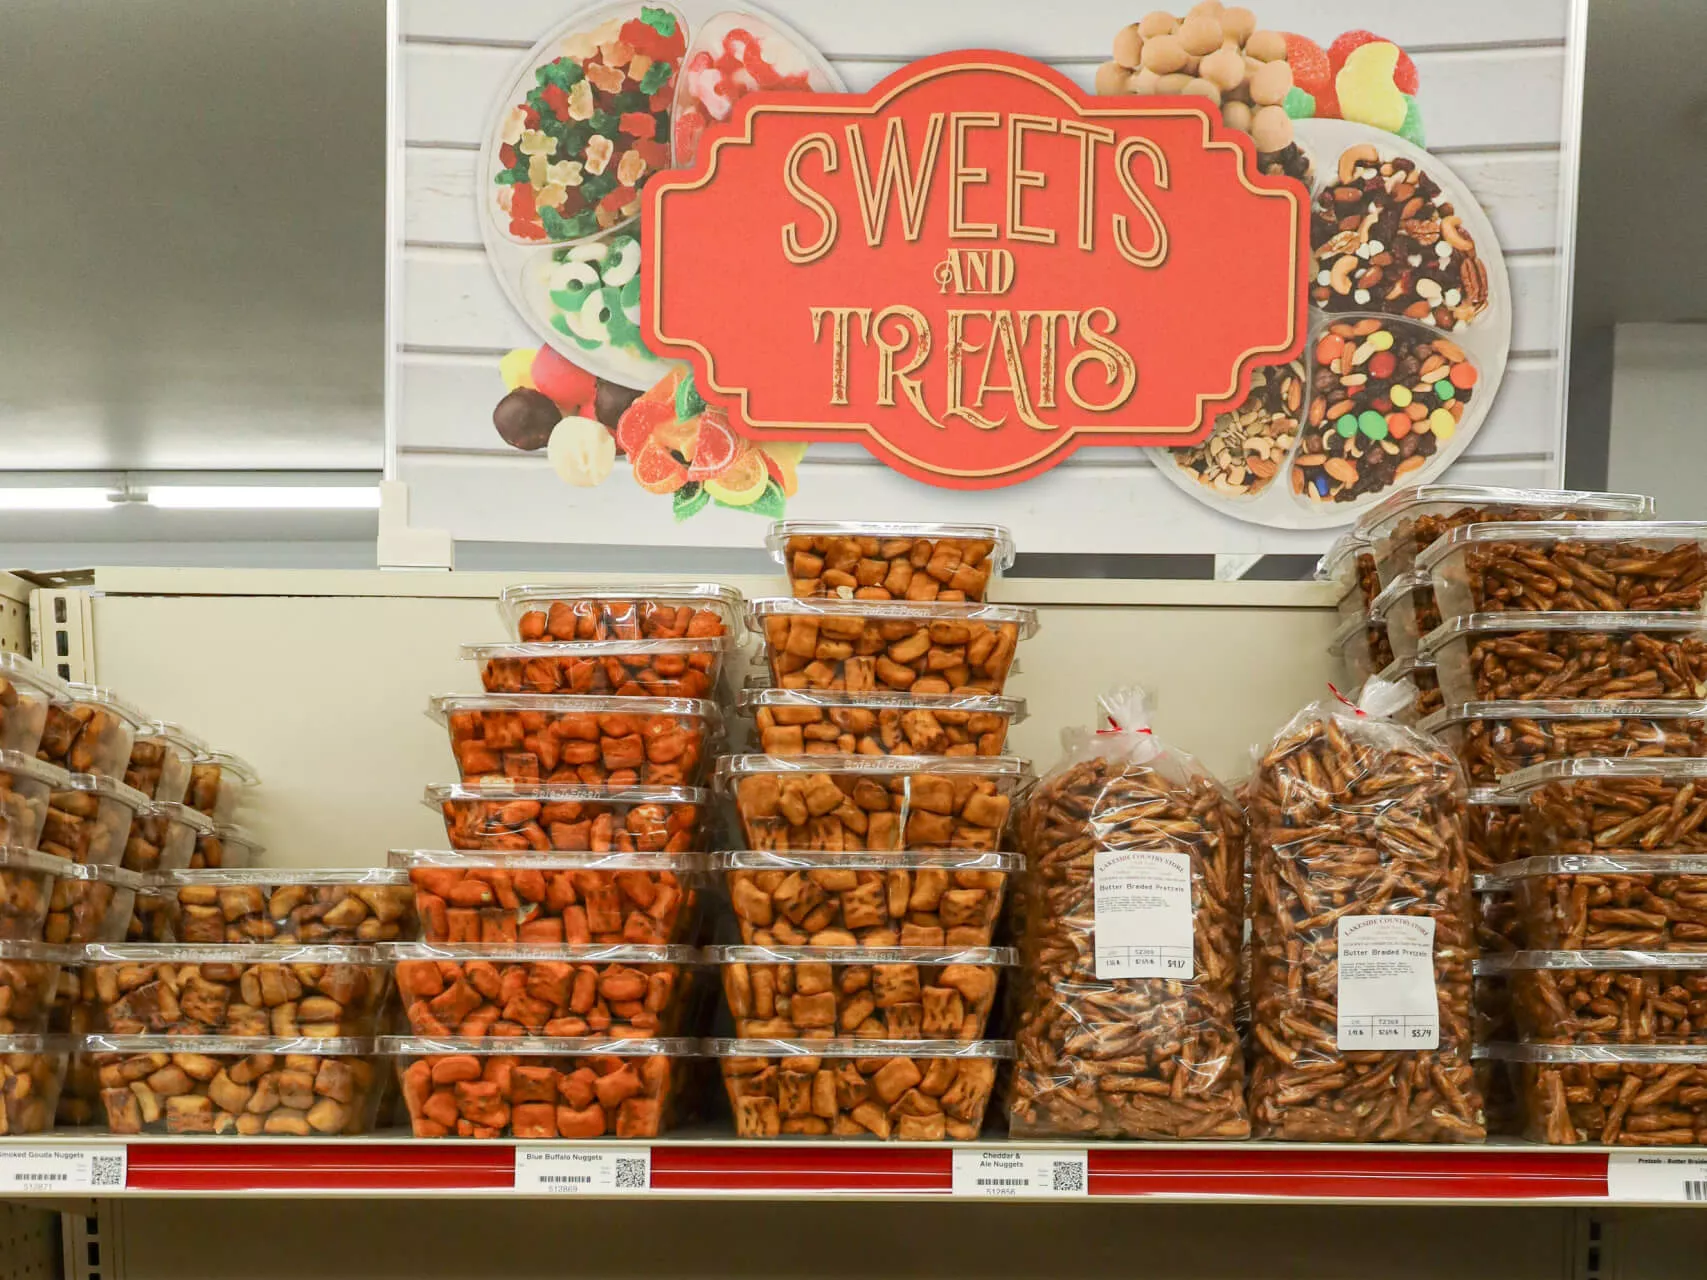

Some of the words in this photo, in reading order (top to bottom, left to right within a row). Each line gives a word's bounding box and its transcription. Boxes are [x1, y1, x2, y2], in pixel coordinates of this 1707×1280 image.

[783, 111, 1169, 268] SWEETS
[933, 247, 1016, 295] AND
[812, 304, 1136, 432] TREATS
[1165, 859, 1185, 873] STORE
[1099, 884, 1122, 892] Butter
[1344, 919, 1377, 936] LAKESIDE
[54, 1151, 84, 1159] Nuggets
[572, 1153, 603, 1162] Nuggets
[993, 1161, 1024, 1169] Nuggets
